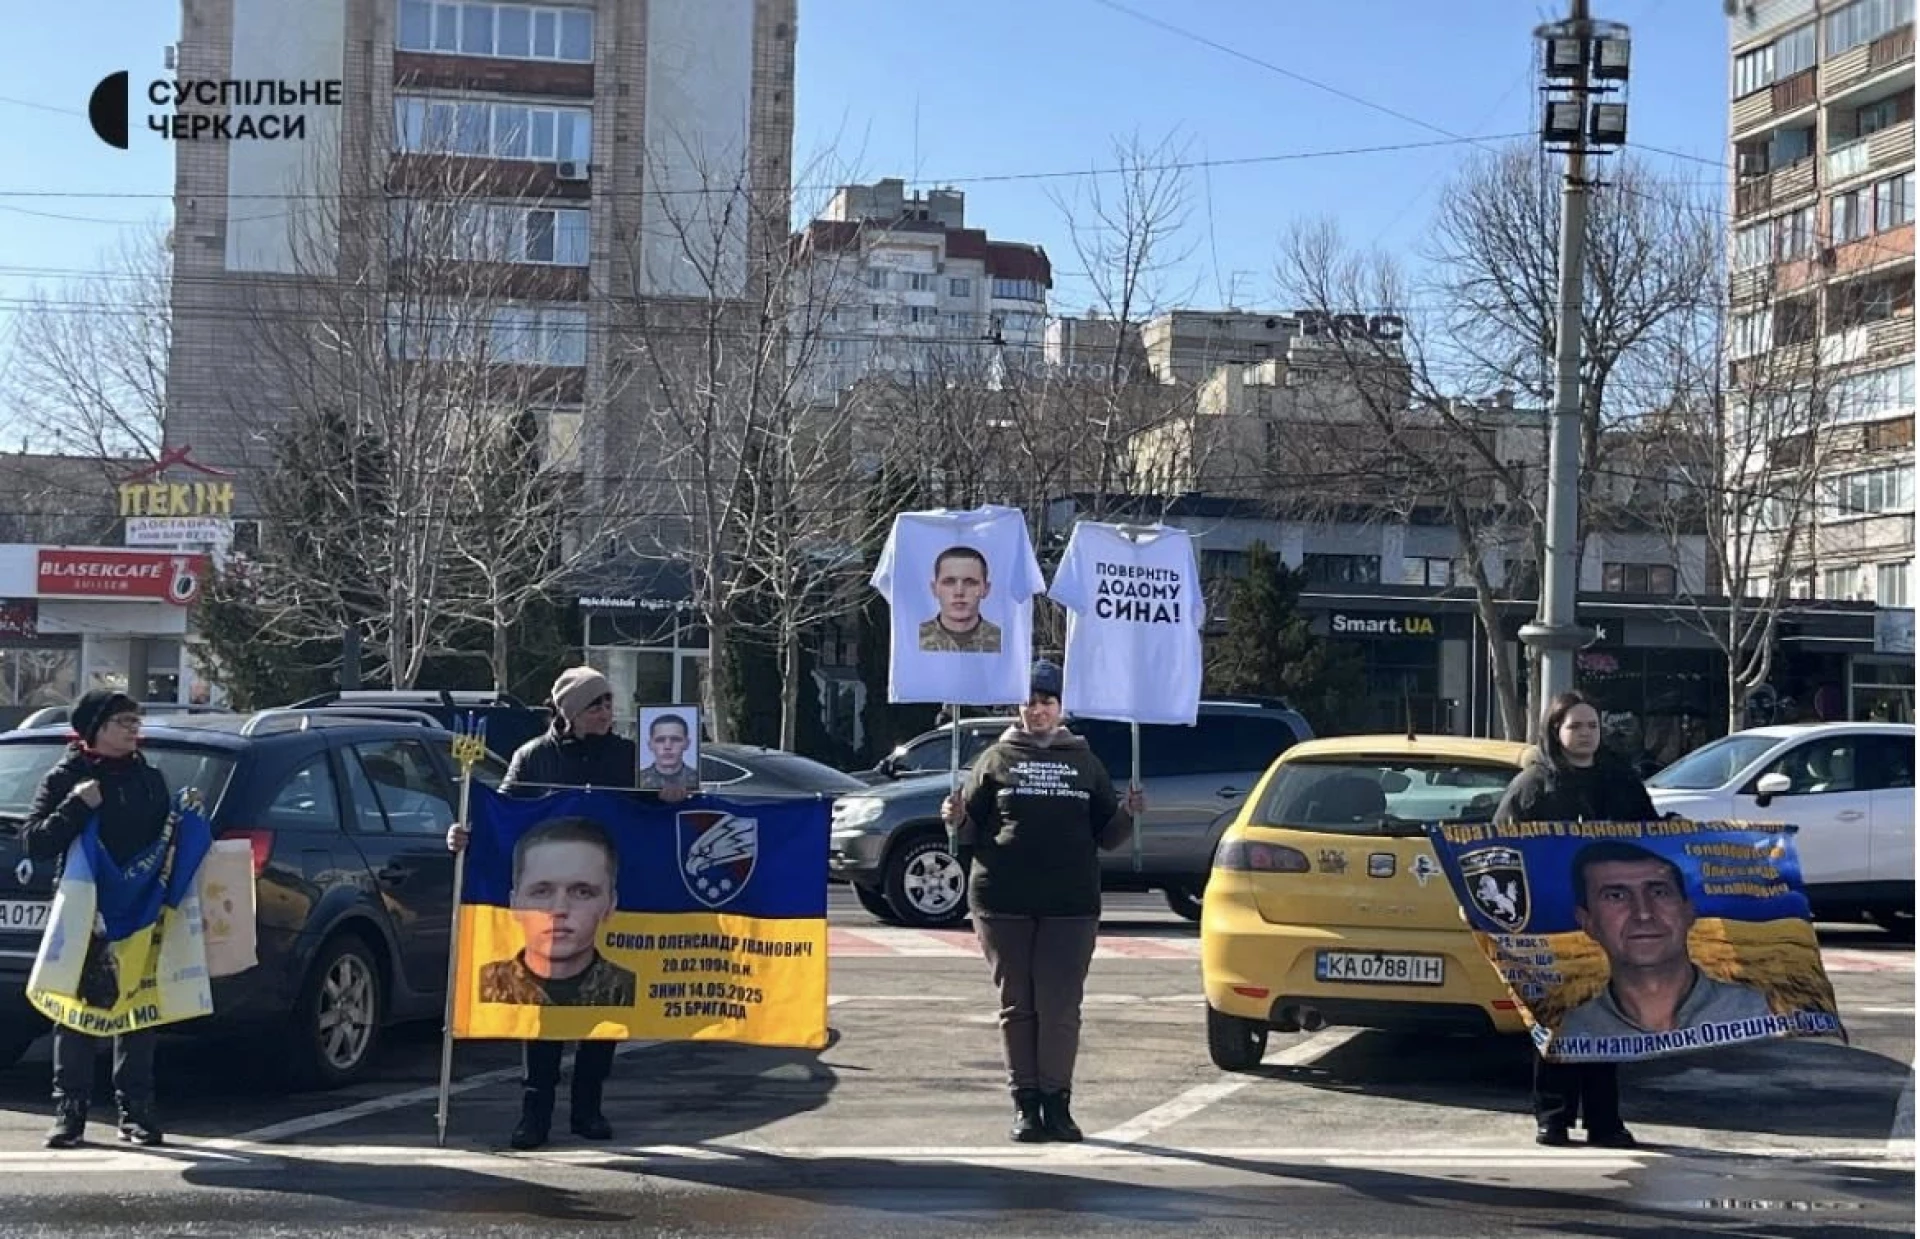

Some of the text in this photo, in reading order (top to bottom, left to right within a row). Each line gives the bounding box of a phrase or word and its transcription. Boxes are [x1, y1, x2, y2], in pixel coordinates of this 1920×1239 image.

[118, 483, 234, 516] ПЕКІН
[40, 561, 163, 578] BLASERCAFÉ
[1096, 562, 1179, 581] ПОВЕРНІТЬ
[1097, 579, 1181, 600] ДОДОМУ
[1096, 597, 1180, 623] СИНА!
[1332, 614, 1434, 633] Smart.UA
[12, 904, 51, 926] 017
[688, 981, 764, 1005] 14.05.2025
[664, 1001, 747, 1019] 25 БРИГАДА
[1597, 1027, 1697, 1055] напрямок
